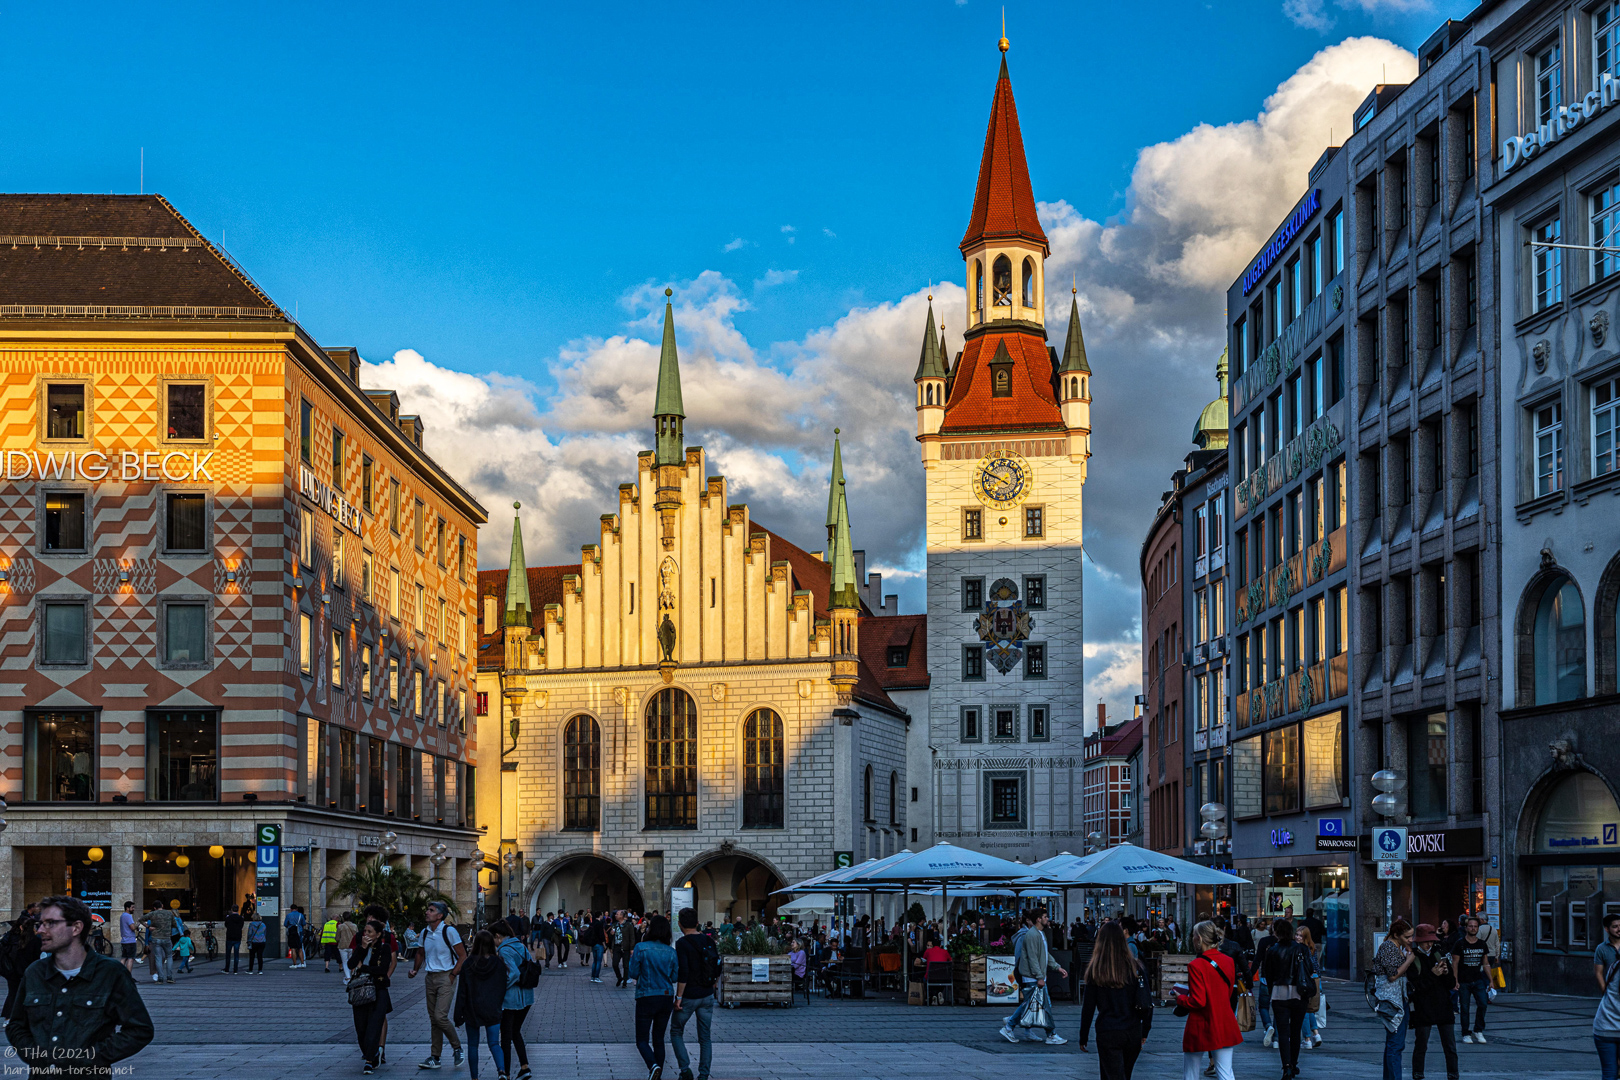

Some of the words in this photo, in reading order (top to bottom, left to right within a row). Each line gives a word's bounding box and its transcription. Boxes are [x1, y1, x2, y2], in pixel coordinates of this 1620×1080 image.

[1243, 189, 1321, 297] AUGENTAGESKLINIK
[0, 451, 109, 481] DWIG
[122, 451, 214, 481] BECK
[300, 465, 338, 518] LUDWIG
[340, 496, 363, 539] BECK
[262, 827, 275, 842] S
[1278, 828, 1290, 844] Live
[1549, 838, 1580, 847] Deutsche
[1581, 836, 1599, 846] Bank
[1318, 839, 1356, 847] SWAROVSKI
[1407, 833, 1445, 853] ROVSKI
[261, 848, 274, 864] U
[838, 853, 850, 867] S
[1122, 864, 1175, 872] Rischart
